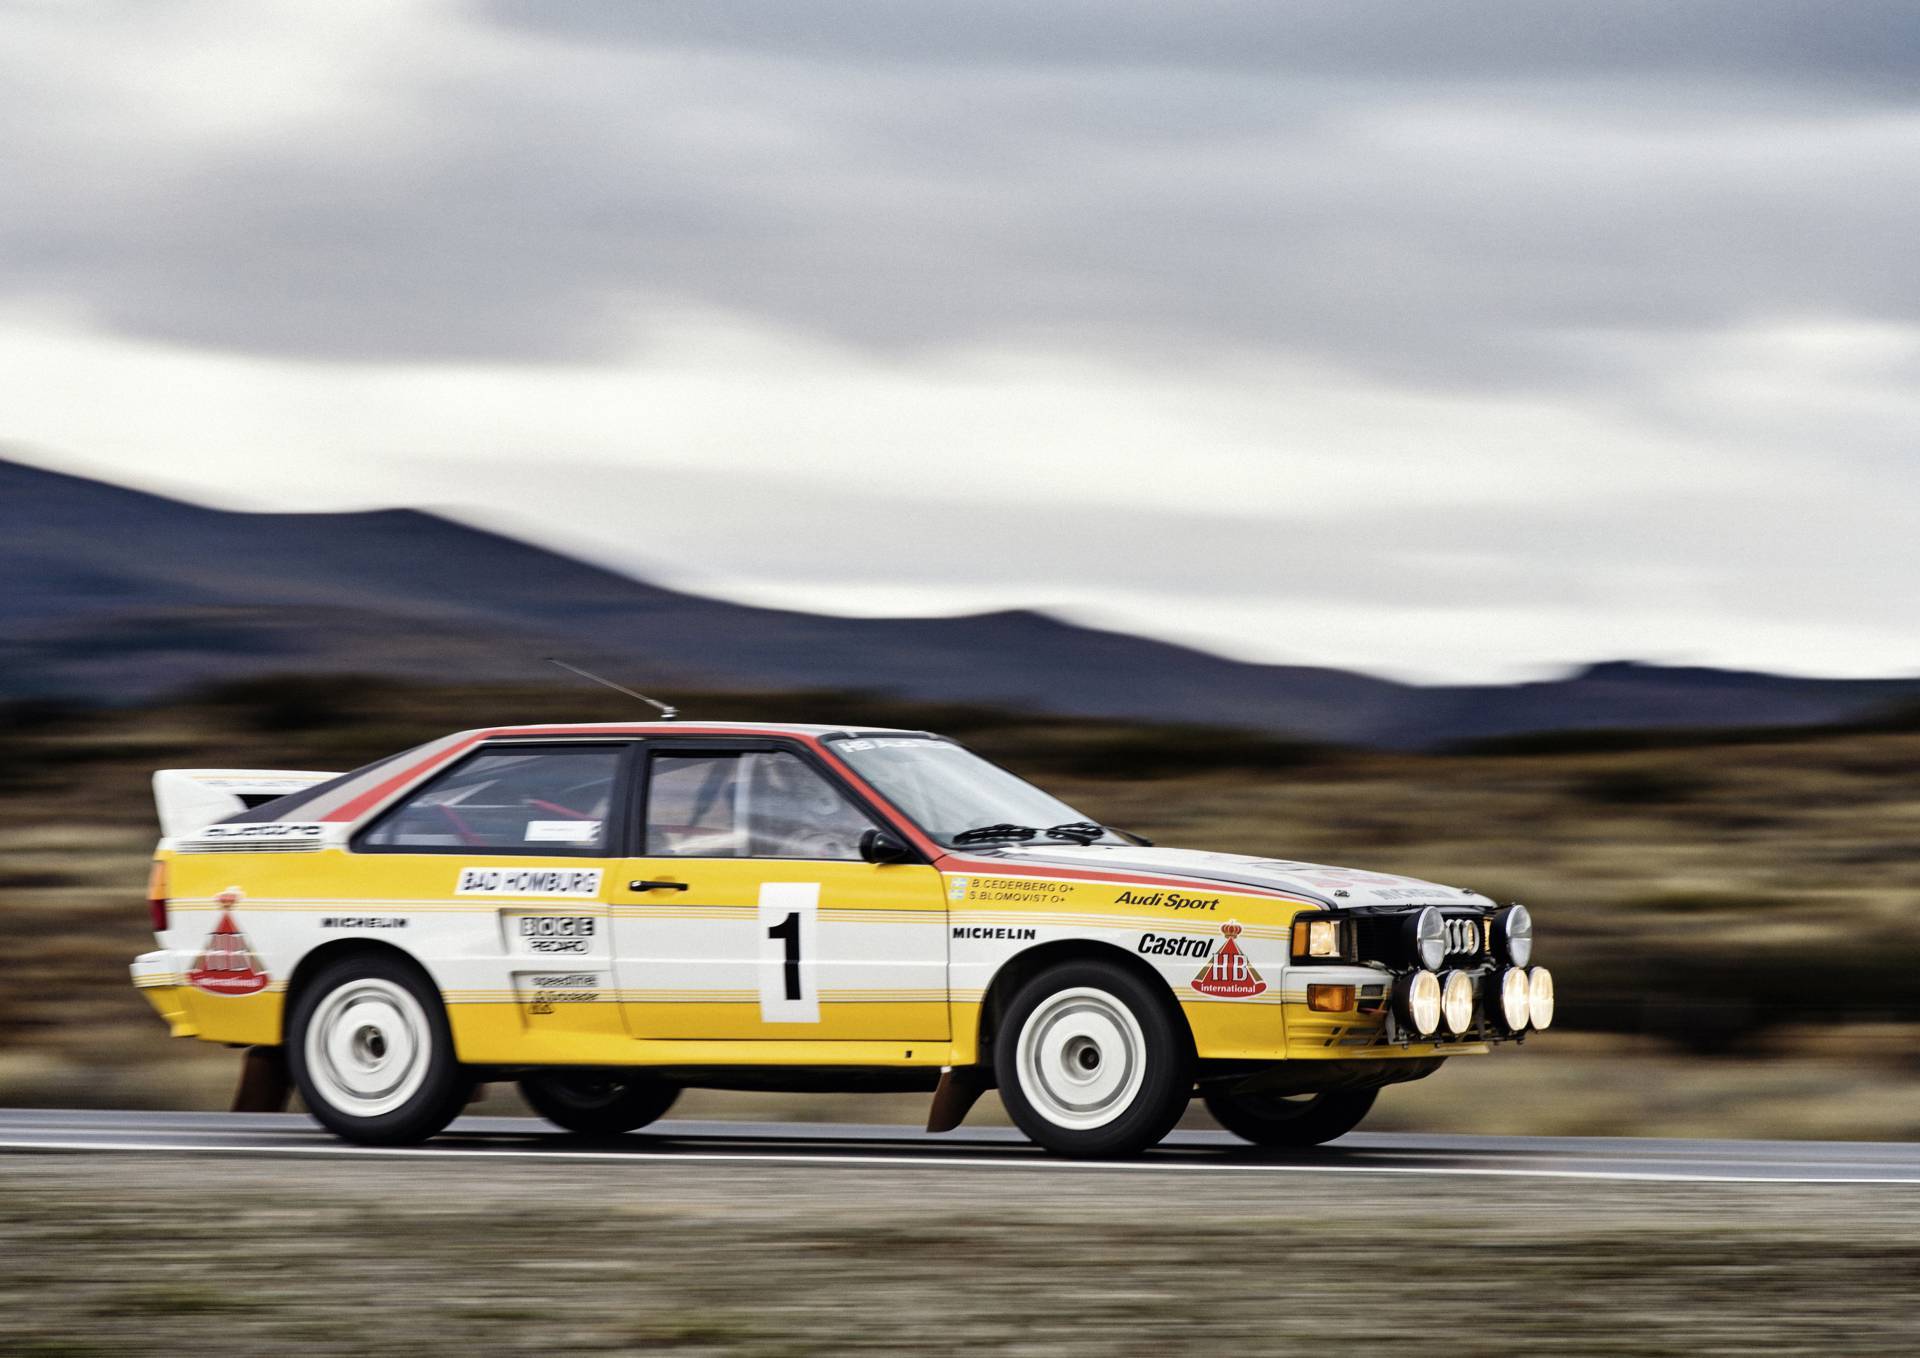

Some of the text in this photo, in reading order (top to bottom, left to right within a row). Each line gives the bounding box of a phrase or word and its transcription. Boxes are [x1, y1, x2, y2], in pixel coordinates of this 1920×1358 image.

[463, 872, 596, 892] BAD HOMBURG
[1114, 891, 1220, 911] Audi Sport
[320, 917, 408, 929] MICHELIN
[520, 917, 595, 936] BOGE
[952, 927, 1036, 940] MICHELIN
[1137, 933, 1214, 958] Castrol
[768, 912, 802, 1000] 1
[1212, 953, 1248, 983] HB
[1200, 982, 1257, 994] international
